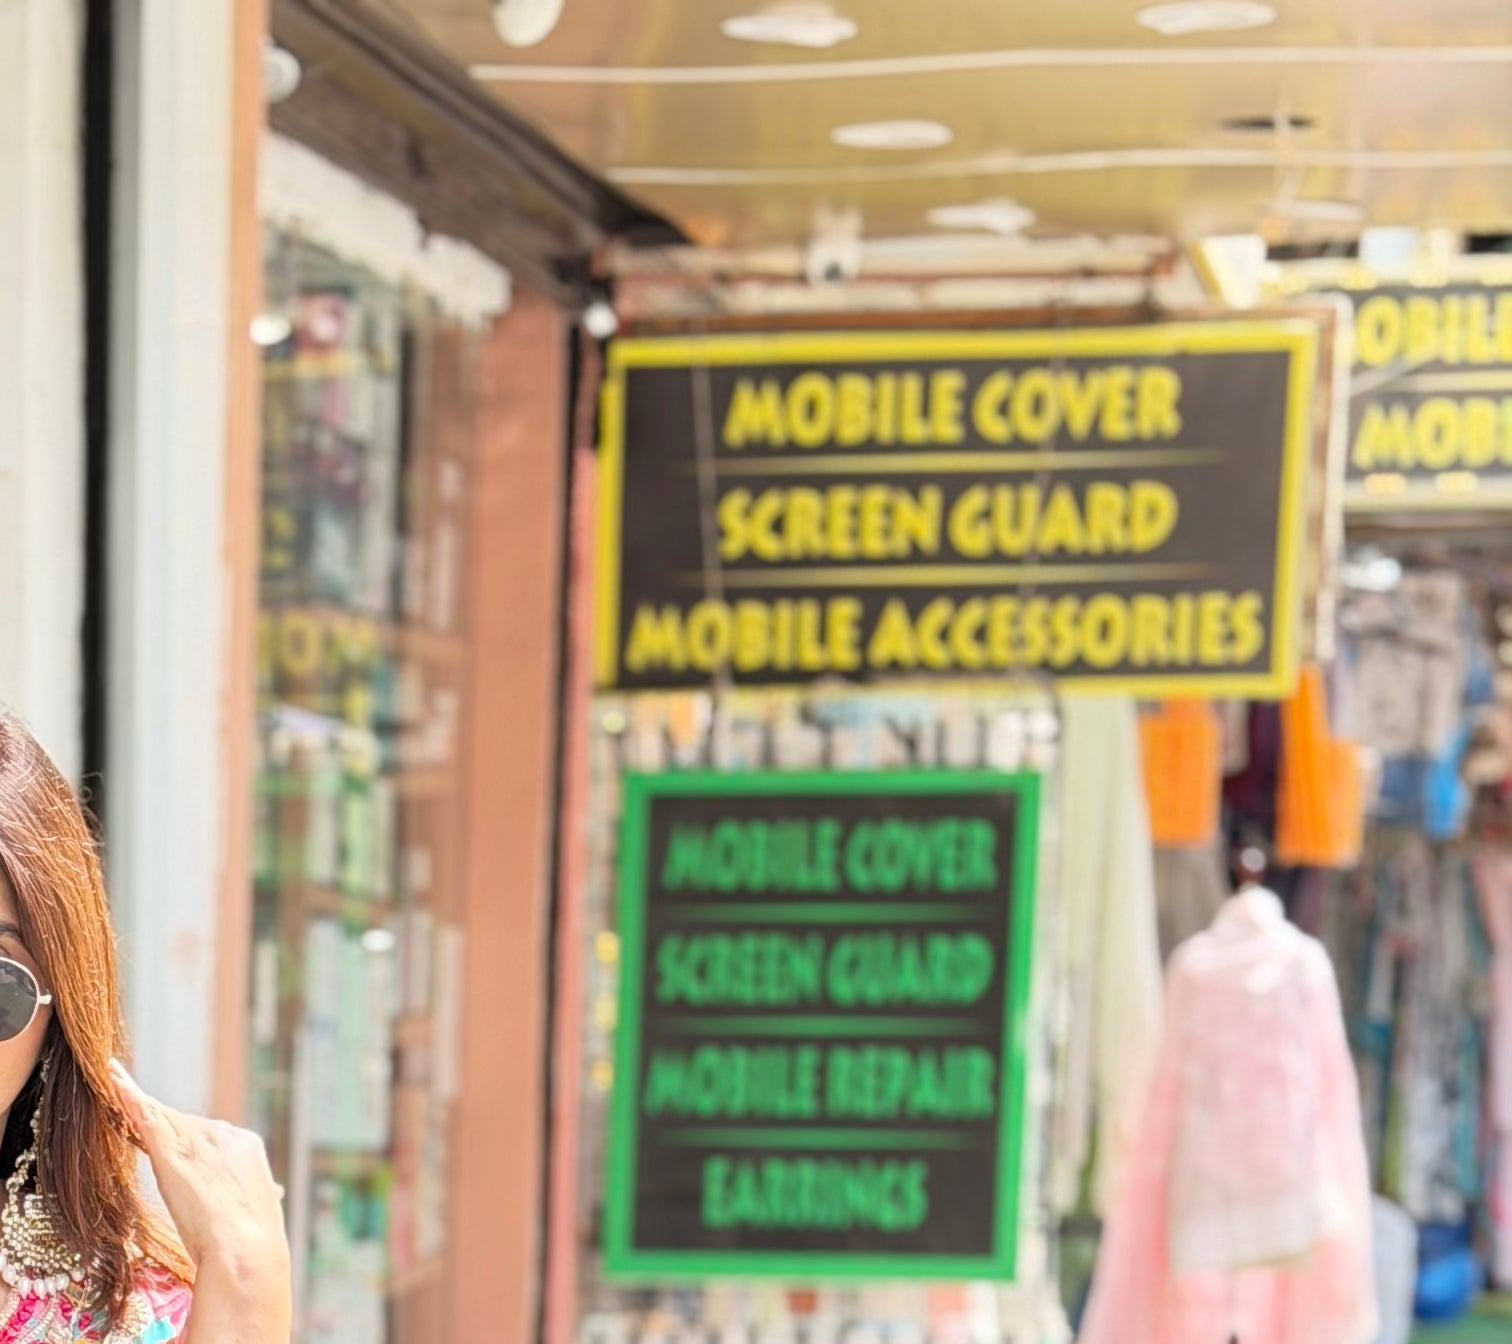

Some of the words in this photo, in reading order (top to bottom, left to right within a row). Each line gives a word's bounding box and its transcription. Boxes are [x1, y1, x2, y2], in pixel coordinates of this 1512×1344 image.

[723, 371, 967, 448] MOBILE
[973, 366, 1182, 443] COVER
[718, 484, 942, 561] SCREEN
[948, 480, 1179, 558] GUARD
[625, 598, 863, 672] MOBILE
[868, 590, 1264, 669] ACCESSORIES
[663, 817, 842, 892] MOBILE
[844, 816, 998, 891] COVER
[655, 931, 824, 1004] SCREEN
[827, 931, 995, 1005] GUARD
[645, 1045, 821, 1119] MOBILE
[825, 1045, 995, 1119] REPAIR
[701, 1155, 929, 1232] EARRINGS
